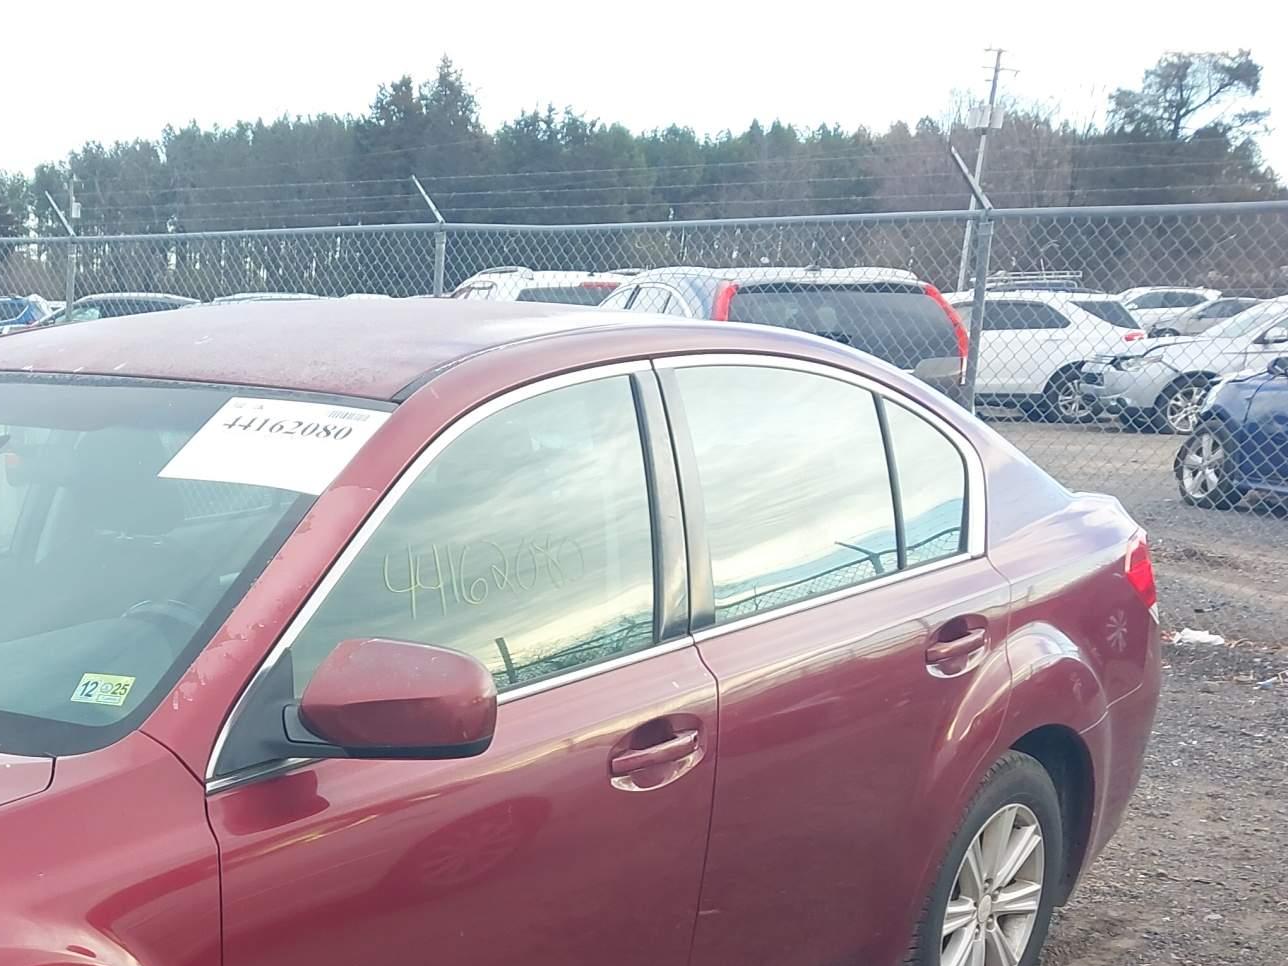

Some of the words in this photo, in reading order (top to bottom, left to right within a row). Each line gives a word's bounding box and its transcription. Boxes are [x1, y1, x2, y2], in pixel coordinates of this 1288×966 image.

[223, 415, 353, 441] 44162080
[383, 534, 585, 620] 44162080
[80, 680, 99, 697] 12
[111, 682, 130, 696] 25
